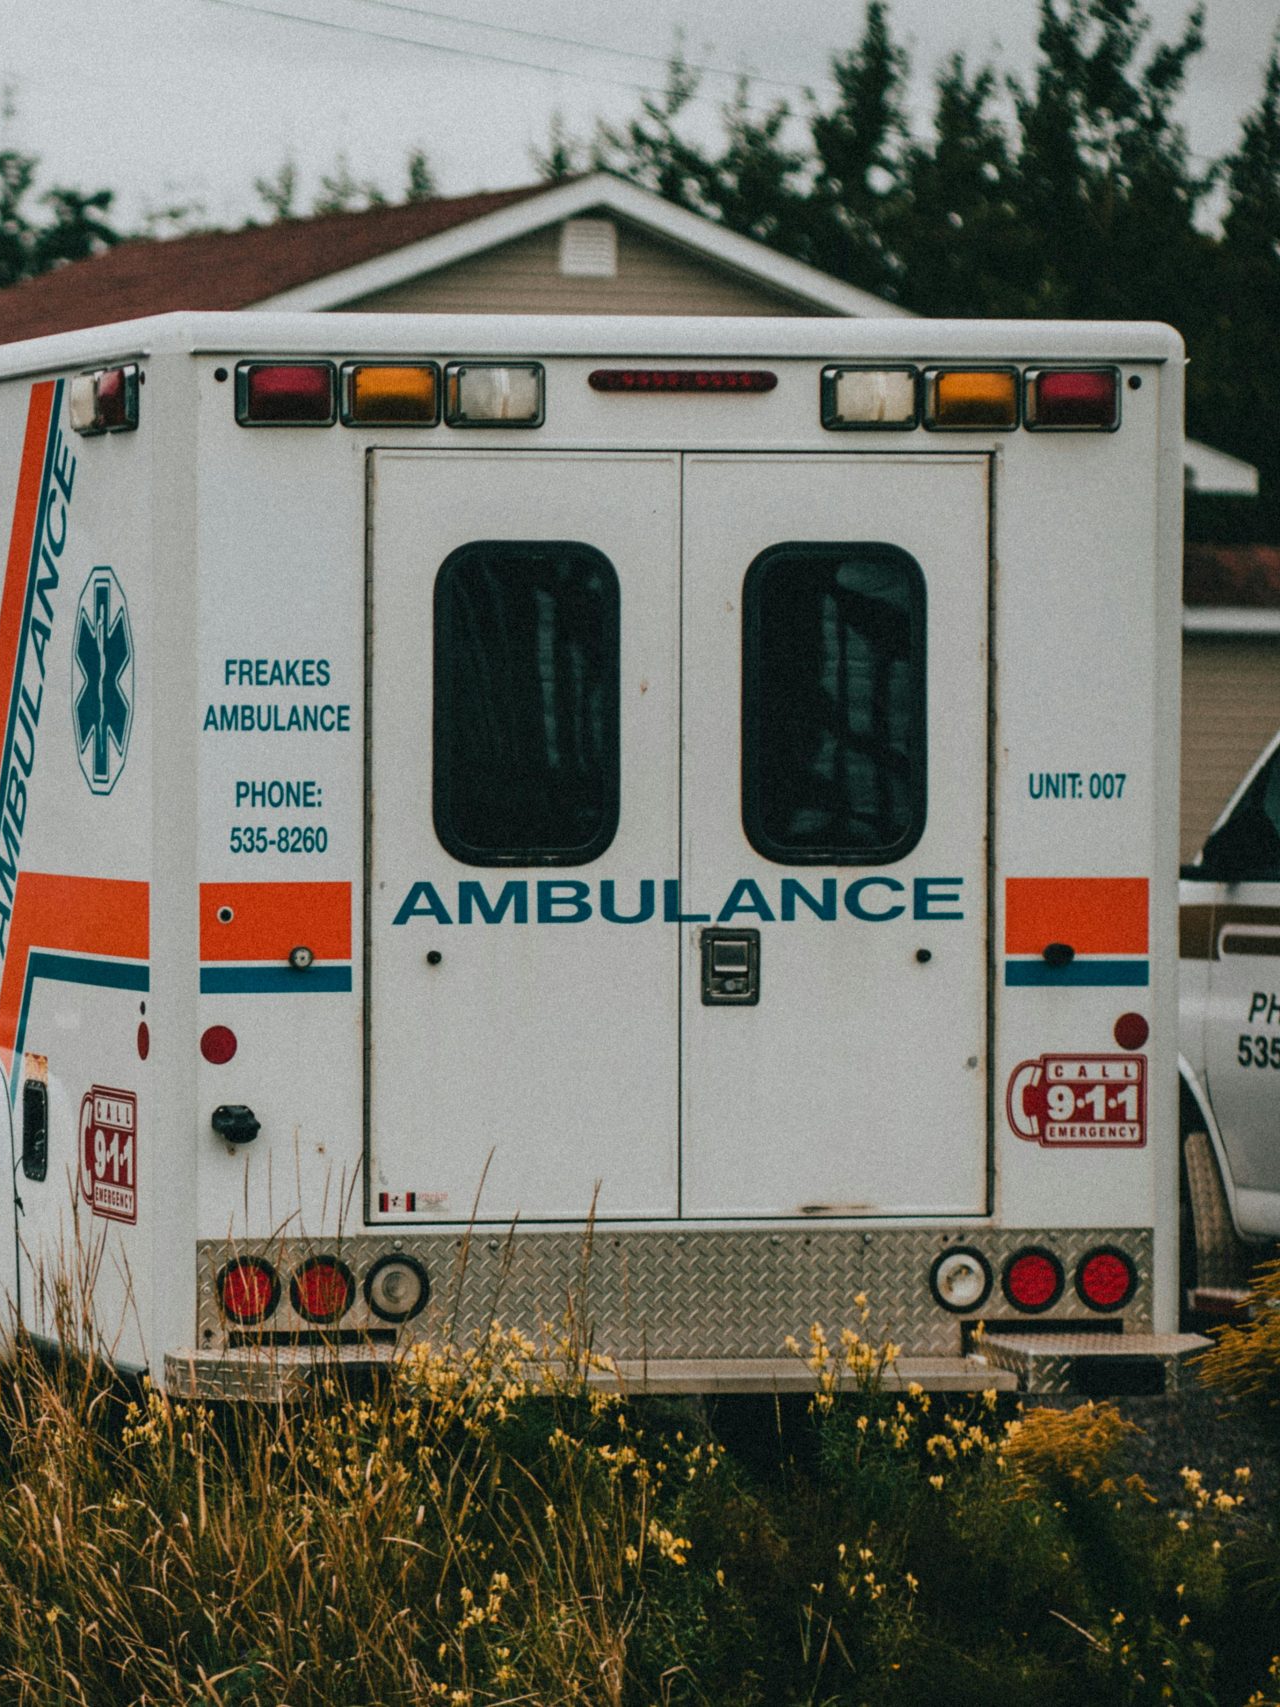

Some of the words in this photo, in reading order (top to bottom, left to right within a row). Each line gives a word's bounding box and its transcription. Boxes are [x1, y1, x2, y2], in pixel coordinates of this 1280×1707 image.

[224, 658, 331, 687] FREAKES
[202, 704, 351, 732] AMBULANCE
[235, 780, 322, 808] PHONE:
[1028, 772, 1083, 799] UNIT:
[1089, 772, 1127, 799] 007
[229, 826, 329, 854] 535-8260
[391, 876, 964, 925] AMBULANCE
[1054, 1064, 1133, 1078] CALL
[96, 1101, 131, 1125] CALL
[1048, 1126, 1137, 1138] EMERGENCY
[95, 1186, 133, 1210] EMERGENCY
